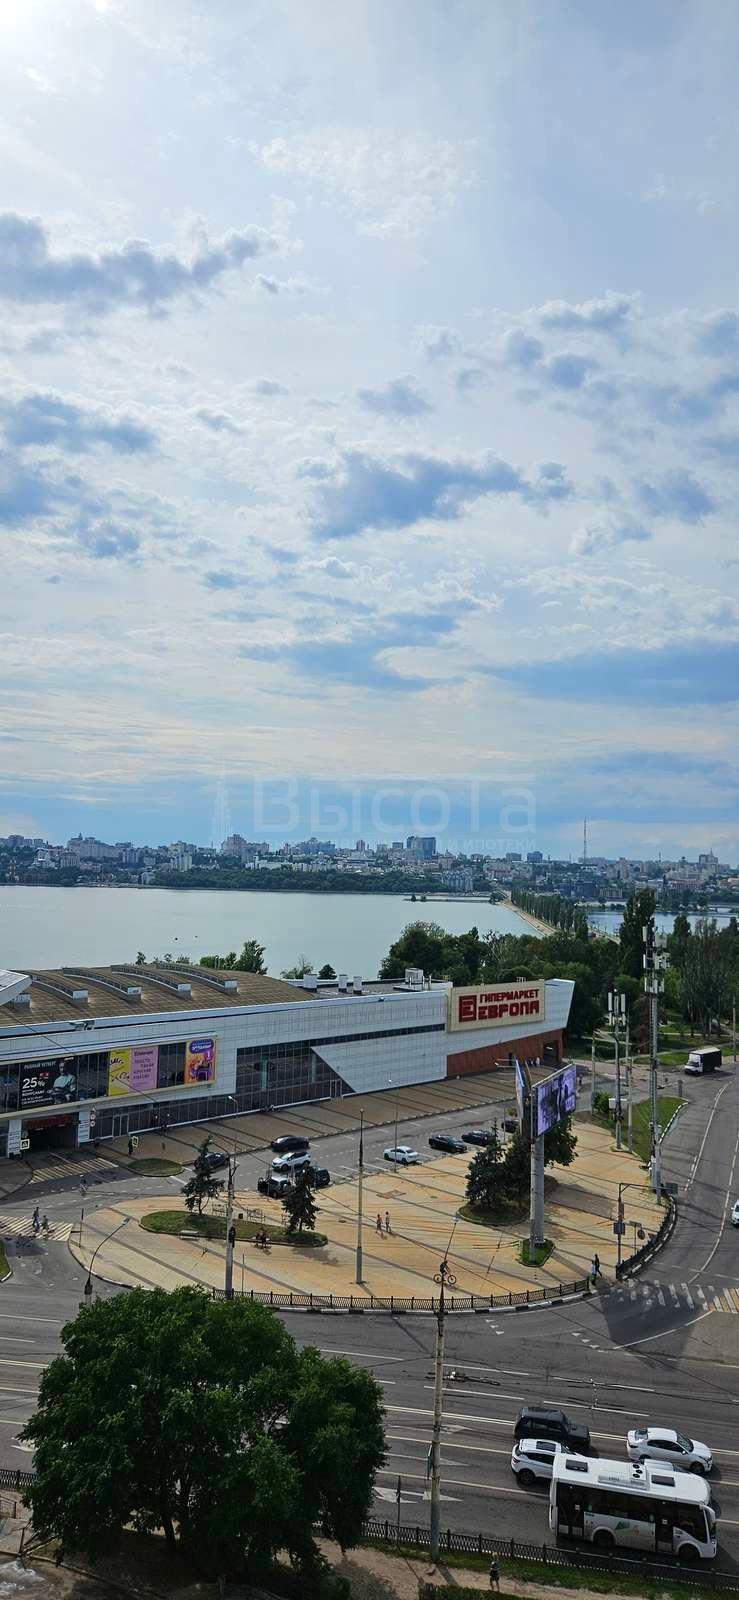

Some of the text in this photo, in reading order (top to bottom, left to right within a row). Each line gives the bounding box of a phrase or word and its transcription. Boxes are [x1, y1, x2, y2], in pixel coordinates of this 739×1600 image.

[480, 989, 539, 1003] ГИПЕРМАРКЕТ
[478, 1001, 539, 1020] ЕВРОПА
[22, 1076, 46, 1088] 25%
